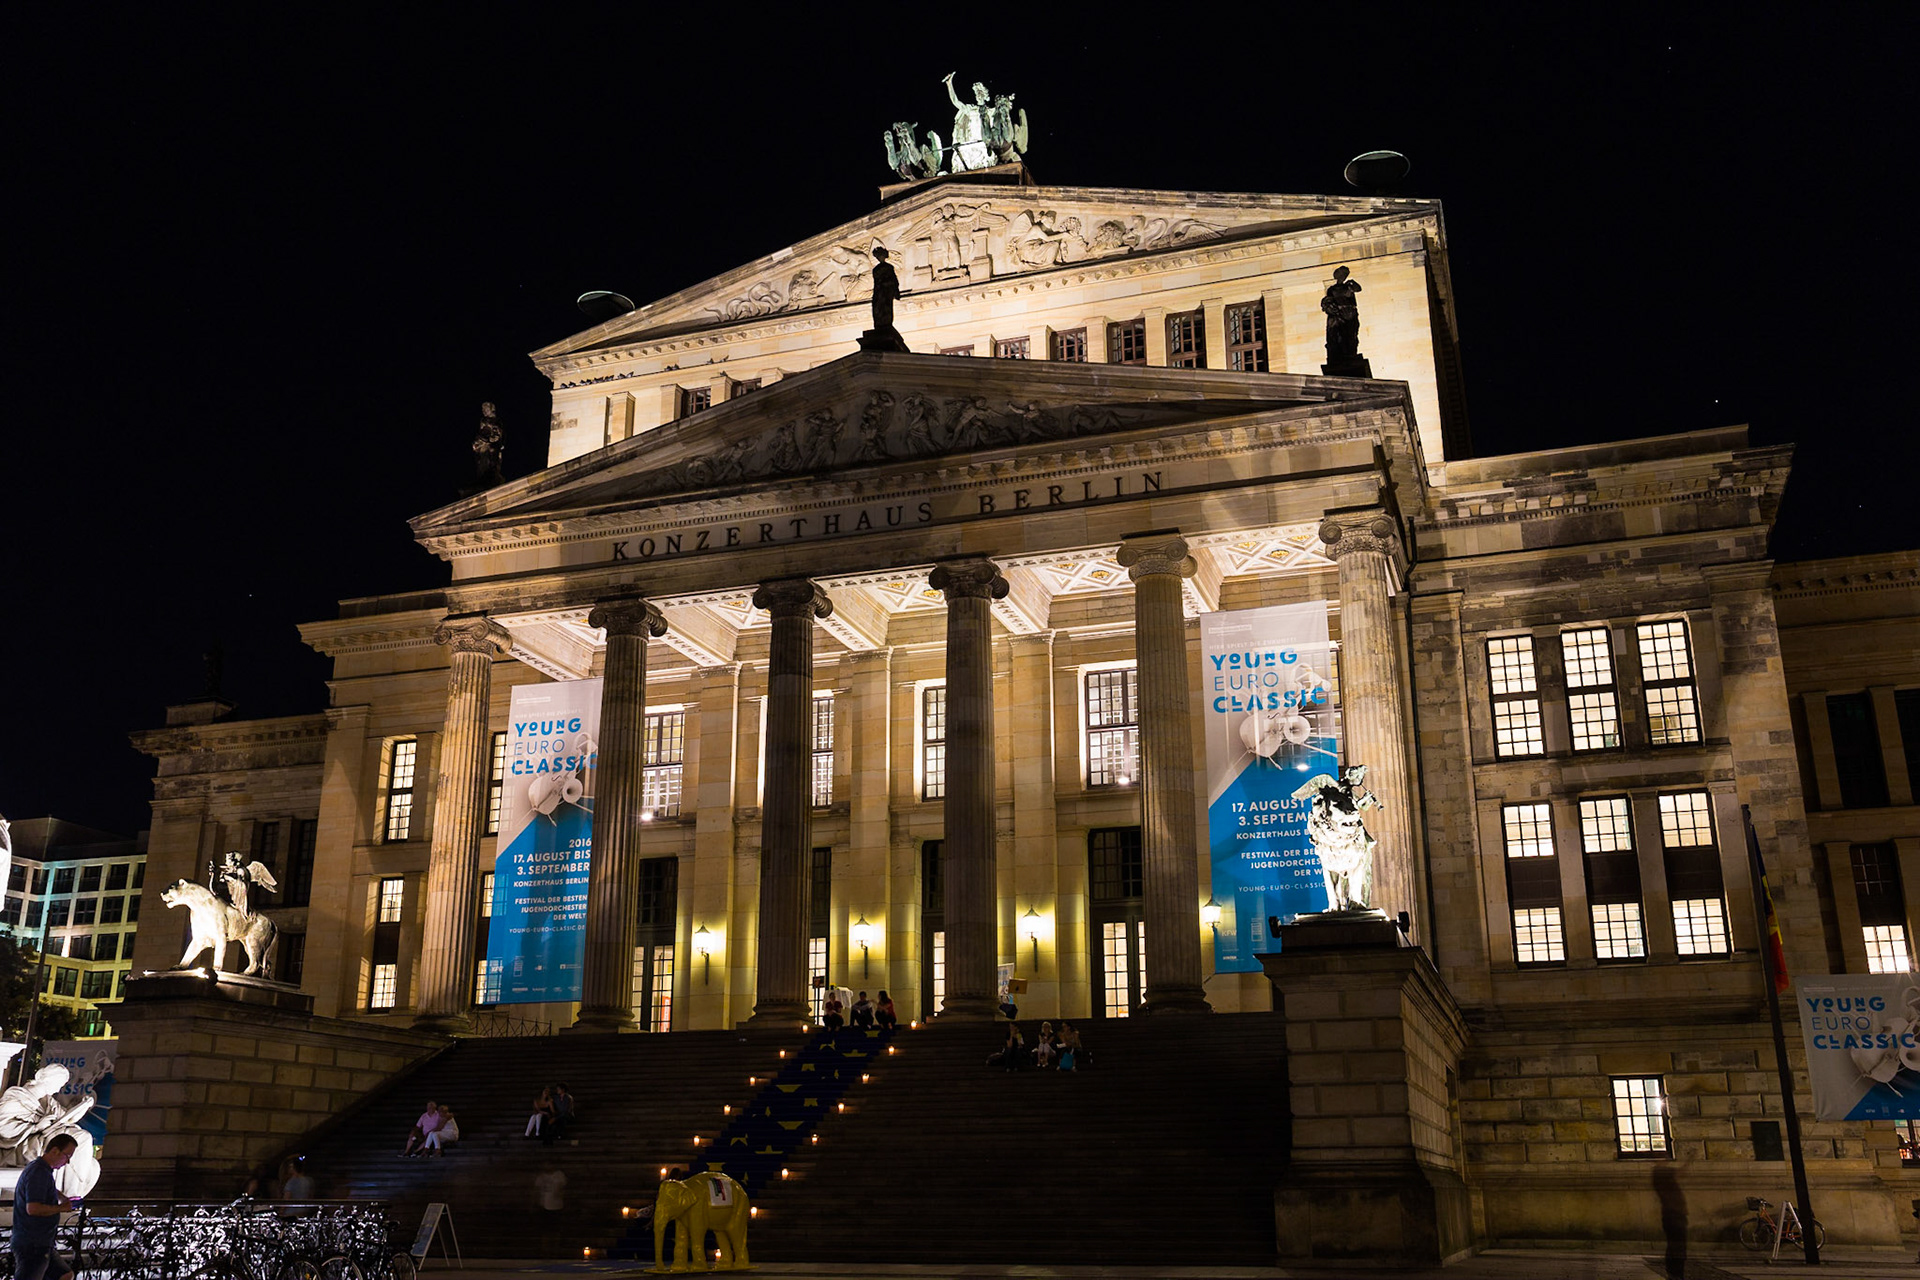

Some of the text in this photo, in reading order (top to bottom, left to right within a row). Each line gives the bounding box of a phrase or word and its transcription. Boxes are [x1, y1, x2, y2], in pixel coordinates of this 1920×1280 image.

[612, 471, 1161, 561] KONZERTHAUS BERLIN
[1210, 648, 1298, 671] YOUNG
[1214, 672, 1279, 691] EURO
[1213, 687, 1326, 713] CLASSIC
[515, 718, 581, 737] YOUNG
[514, 739, 565, 756] EURO
[511, 753, 598, 775] CLASSIC
[1231, 802, 1246, 813] 17.
[1238, 816, 1250, 826] 3.
[1236, 829, 1301, 840] KONZERTHAUS
[568, 838, 592, 848] 2016
[513, 849, 591, 863] 17. AUGUST BIS
[1241, 850, 1281, 859] FESTIVAL
[1283, 849, 1301, 857] DER
[517, 862, 590, 875] 3. SEPTEMBER
[1294, 869, 1311, 877] DER
[513, 877, 589, 887] KONZERTHAUS BERLIN
[514, 897, 546, 905] FESTIVAL
[563, 894, 588, 902] BESTEN
[521, 903, 587, 913] JUGENDORCHESTER
[568, 912, 586, 920] WELT
[1806, 996, 1885, 1013] YOUNG
[1811, 1016, 1870, 1030] EURO
[1813, 1033, 1916, 1050] CLASSIC
